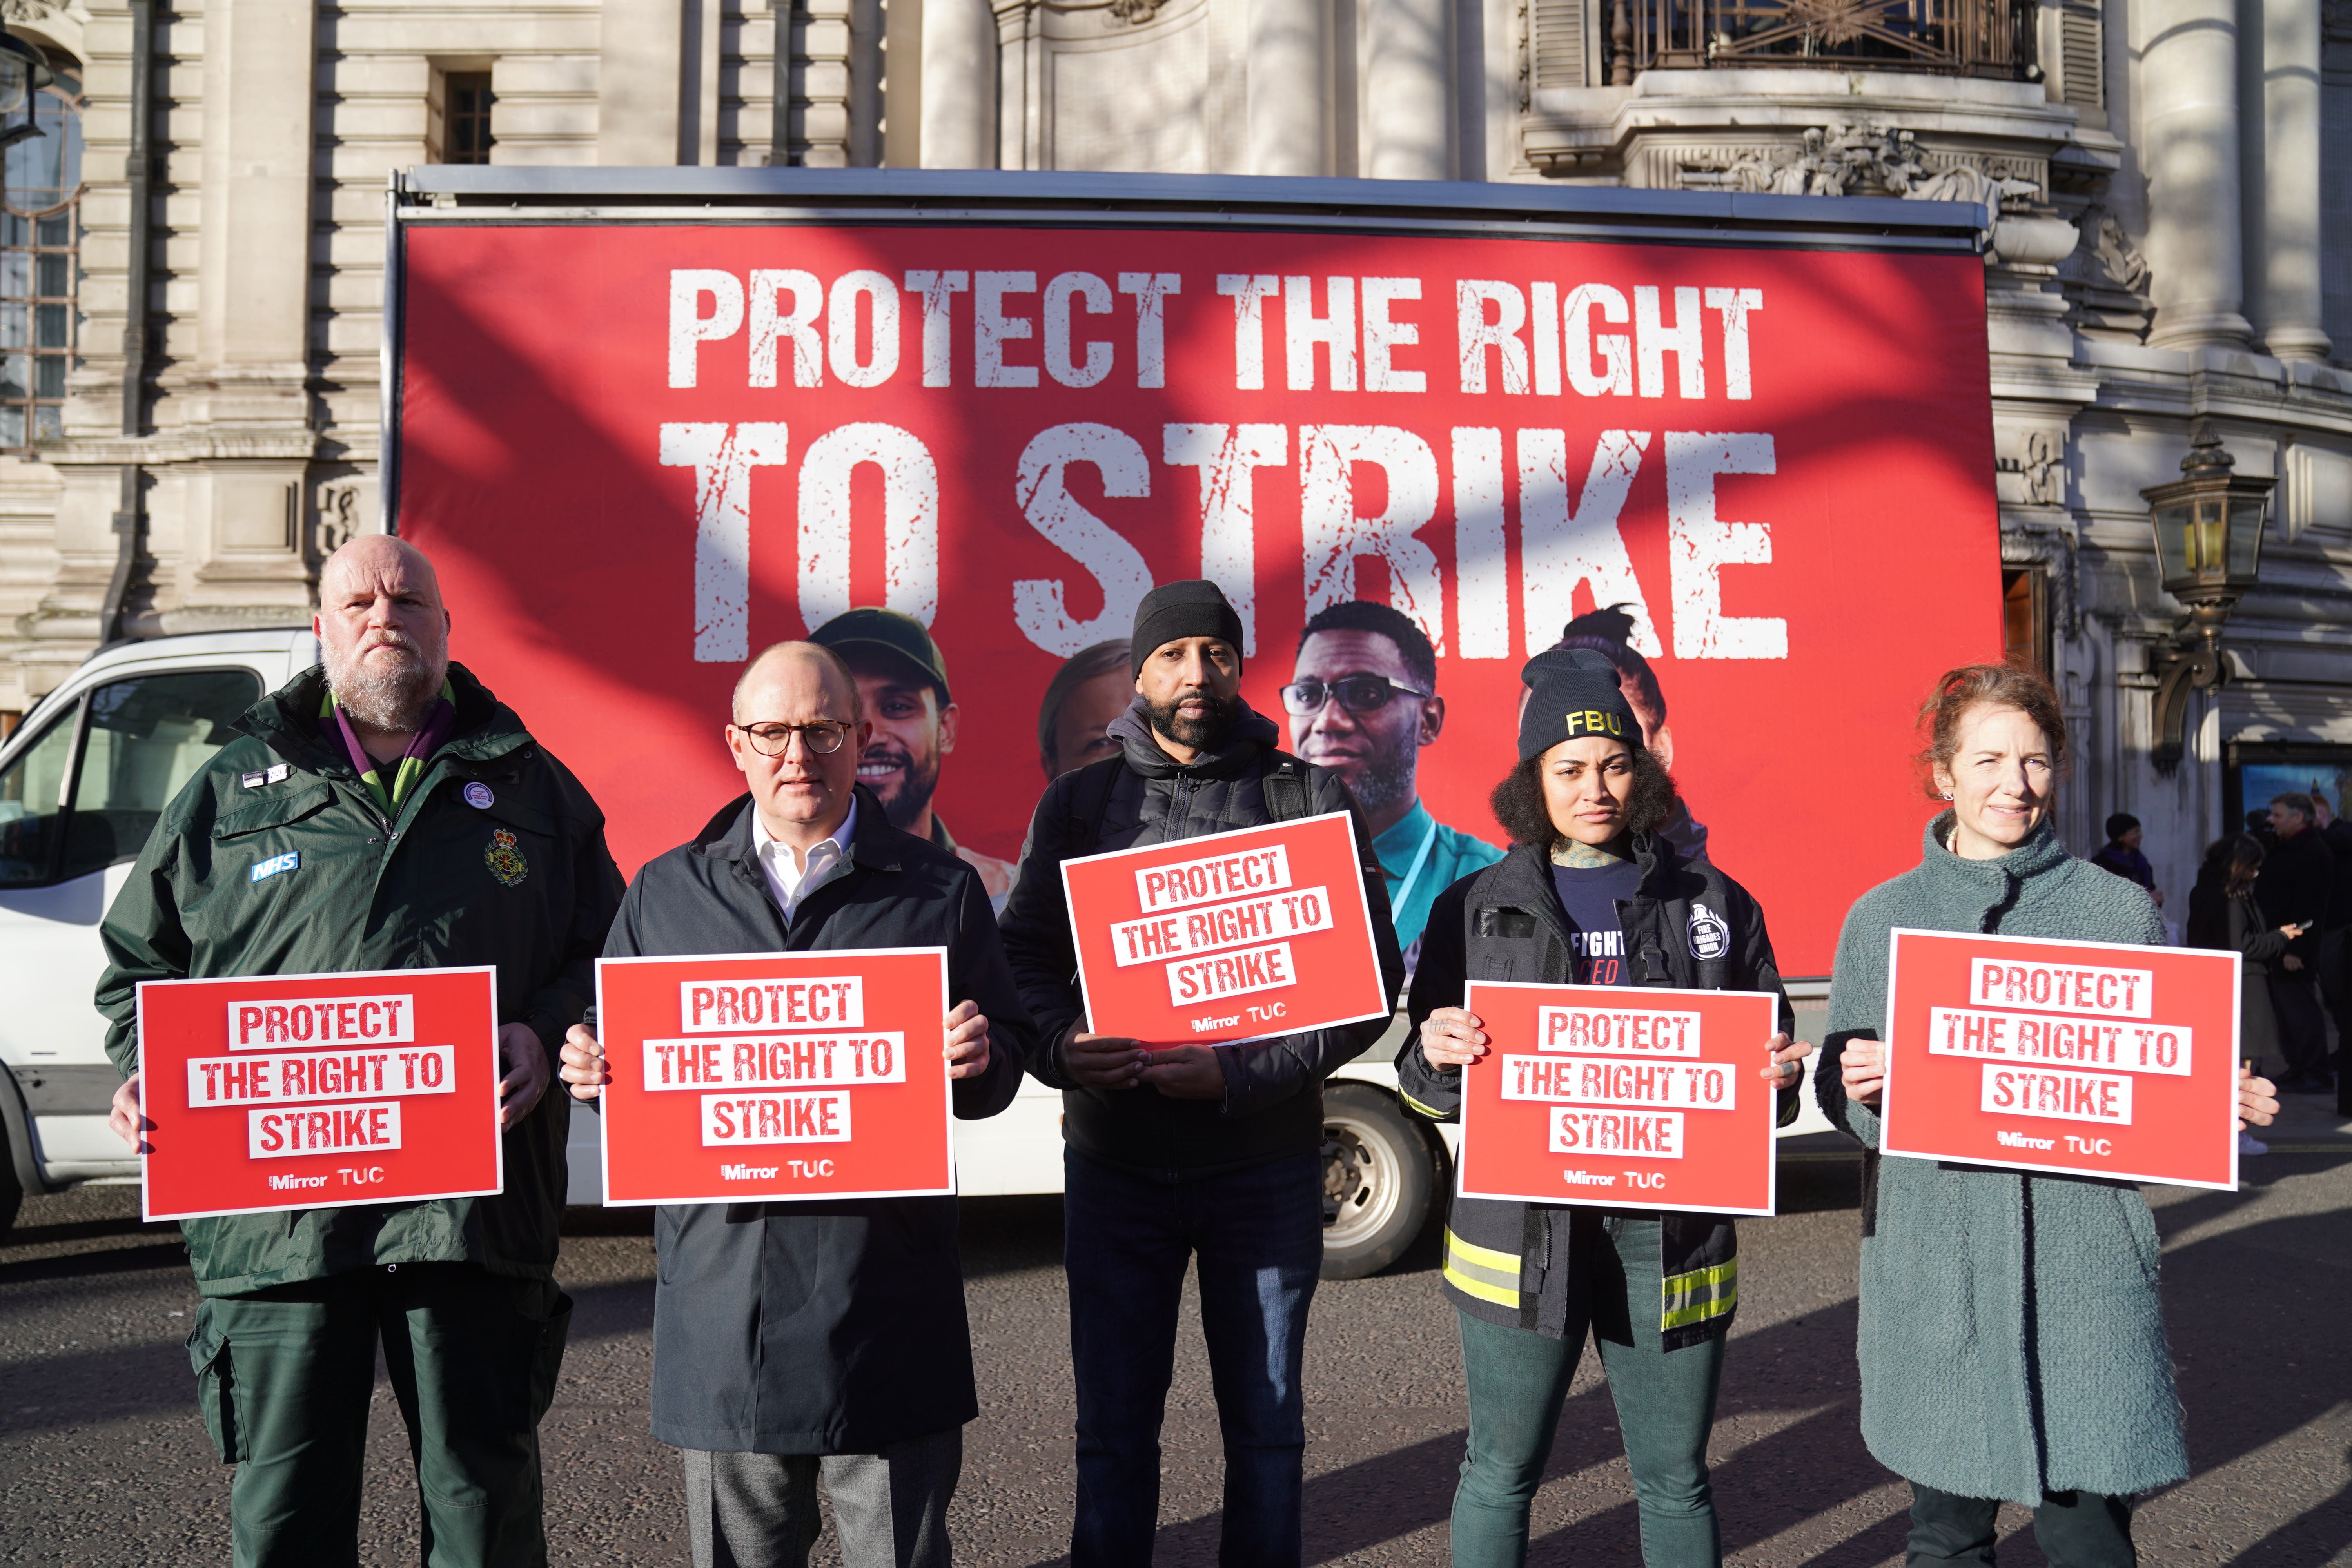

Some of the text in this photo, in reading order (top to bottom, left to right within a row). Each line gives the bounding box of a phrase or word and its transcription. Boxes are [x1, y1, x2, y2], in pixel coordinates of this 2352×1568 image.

[668, 269, 1763, 401] PROTECT THE RIGHT
[659, 421, 1788, 662] TO STRIKE
[1566, 710, 1622, 735] FBU
[253, 853, 296, 881] NHS
[1146, 852, 1276, 906] PROTECT
[1122, 895, 1321, 958] THE RIGHT TO
[1693, 932, 1721, 944] BRIGADES
[1697, 924, 1712, 935] FIRE
[1699, 942, 1719, 953] UNION
[1178, 949, 1285, 998] STRIKE
[1982, 965, 2140, 1010] PROTECT
[240, 1001, 402, 1044] PROTECT
[693, 984, 851, 1025] PROTECT
[1194, 1002, 1287, 1033] Mirror TUC
[1549, 1013, 1690, 1050] PROTECT
[1944, 1014, 2177, 1067] THE RIGHT TO
[200, 1053, 443, 1100] THE RIGHT TO
[656, 1039, 892, 1083] THE RIGHT TO
[1514, 1061, 1723, 1102] THE RIGHT TO
[1994, 1072, 2119, 1117] STRIKE
[261, 1108, 390, 1151] STRIKE
[714, 1098, 839, 1138] STRIKE
[1561, 1114, 1672, 1152] STRIKE
[2000, 1131, 2055, 1150] Mirror
[2063, 1135, 2112, 1156] TUC
[273, 1167, 385, 1190] Mirror TUC
[725, 1159, 834, 1180] Mirror TUC
[1567, 1170, 1615, 1186] Mirror
[1623, 1171, 1666, 1189] TUC
